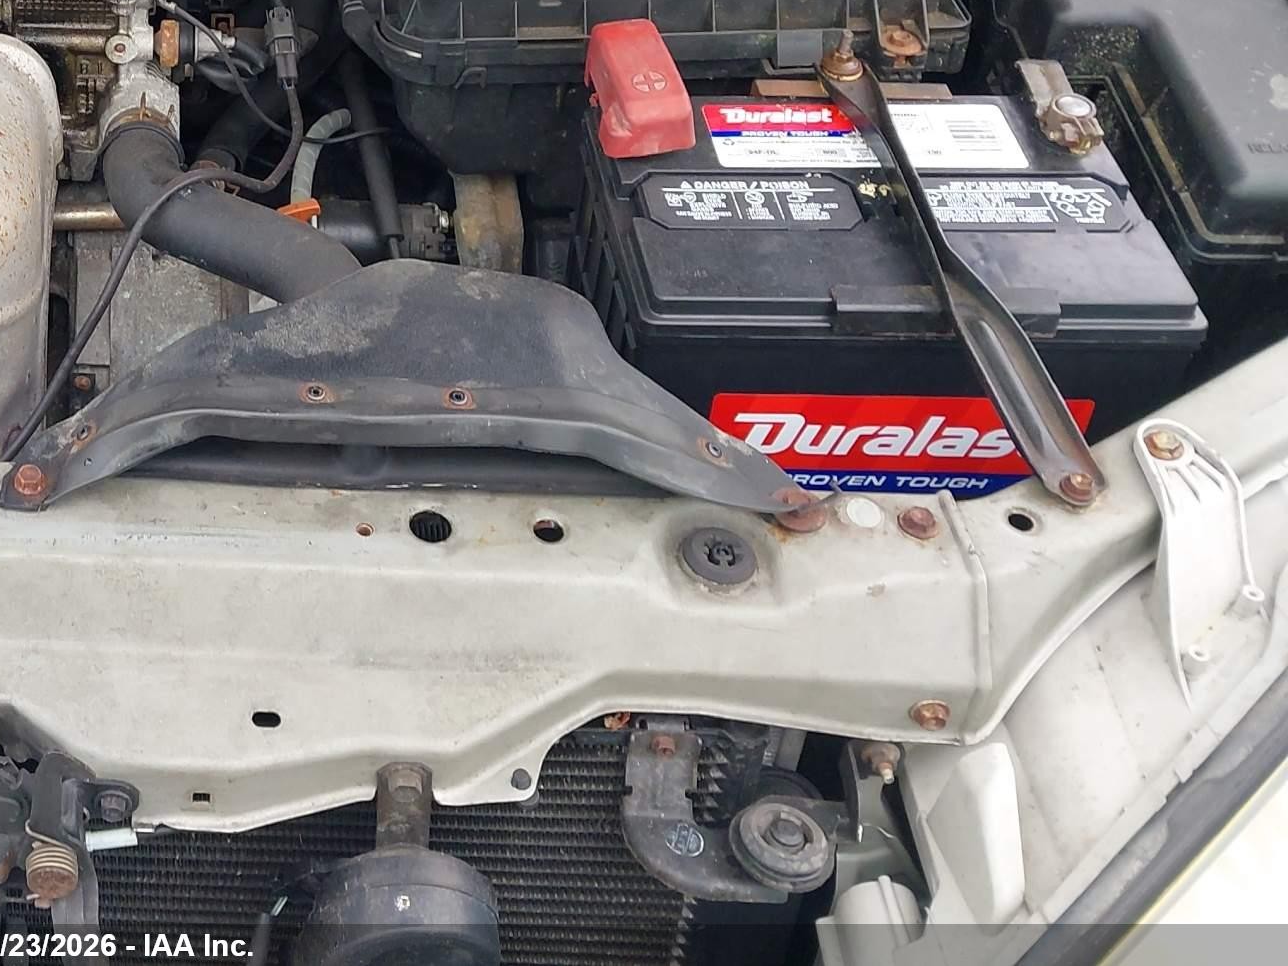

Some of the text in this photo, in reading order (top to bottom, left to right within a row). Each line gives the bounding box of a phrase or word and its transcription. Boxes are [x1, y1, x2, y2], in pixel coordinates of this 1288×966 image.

[719, 107, 833, 125] Duralast
[741, 130, 829, 138] PROVEN TOUGH
[693, 181, 748, 190] DANGER
[760, 181, 810, 190] POISON
[734, 412, 1022, 459] Duralas
[788, 474, 989, 490] ROVEN TOUGH
